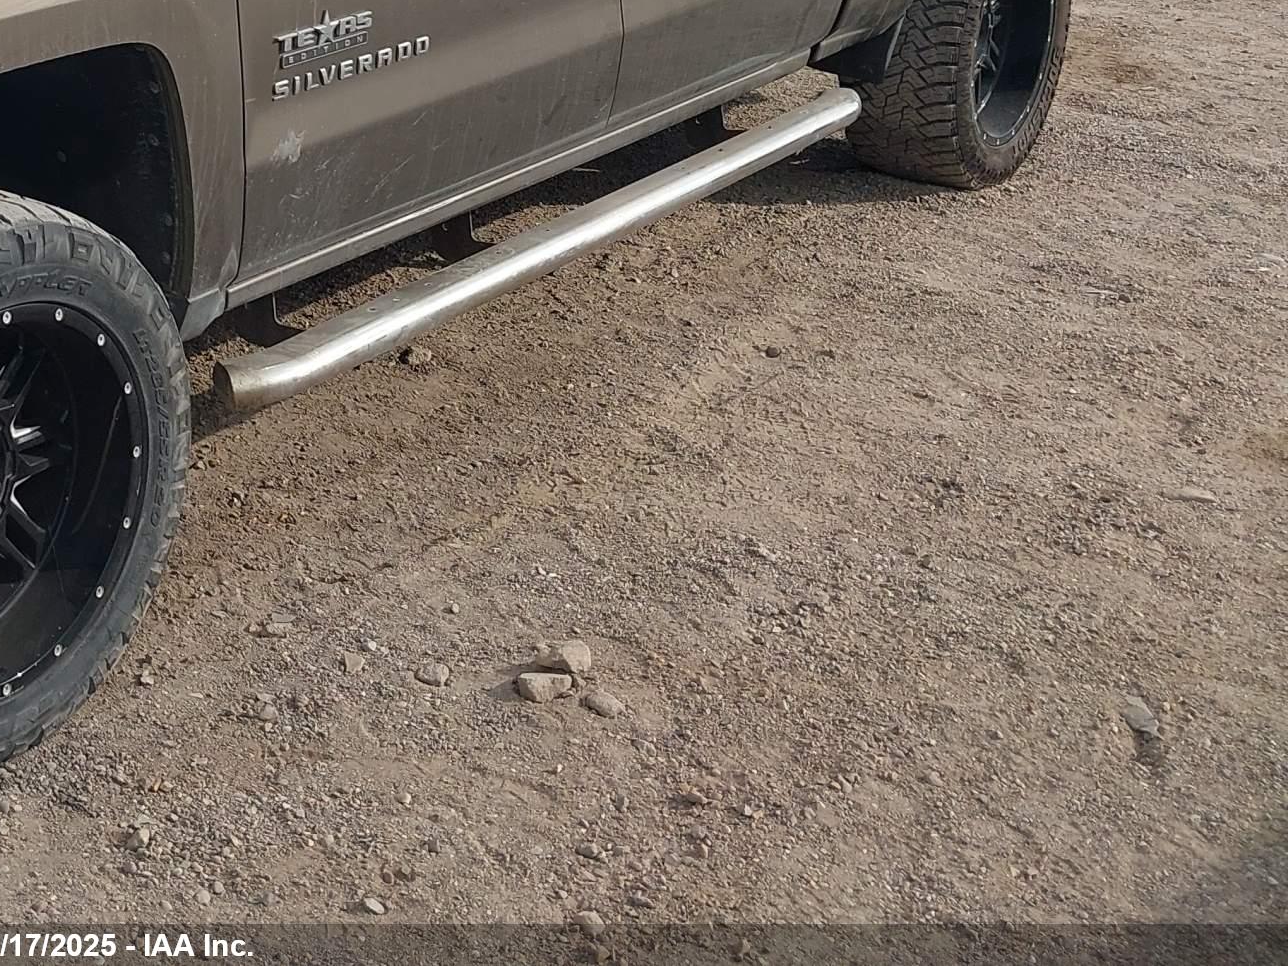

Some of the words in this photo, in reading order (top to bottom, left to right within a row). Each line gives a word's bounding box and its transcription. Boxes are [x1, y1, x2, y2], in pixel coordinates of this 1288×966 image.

[273, 9, 373, 53] TEXAS
[287, 35, 364, 65] EDITION
[272, 35, 430, 101] SILVERADO
